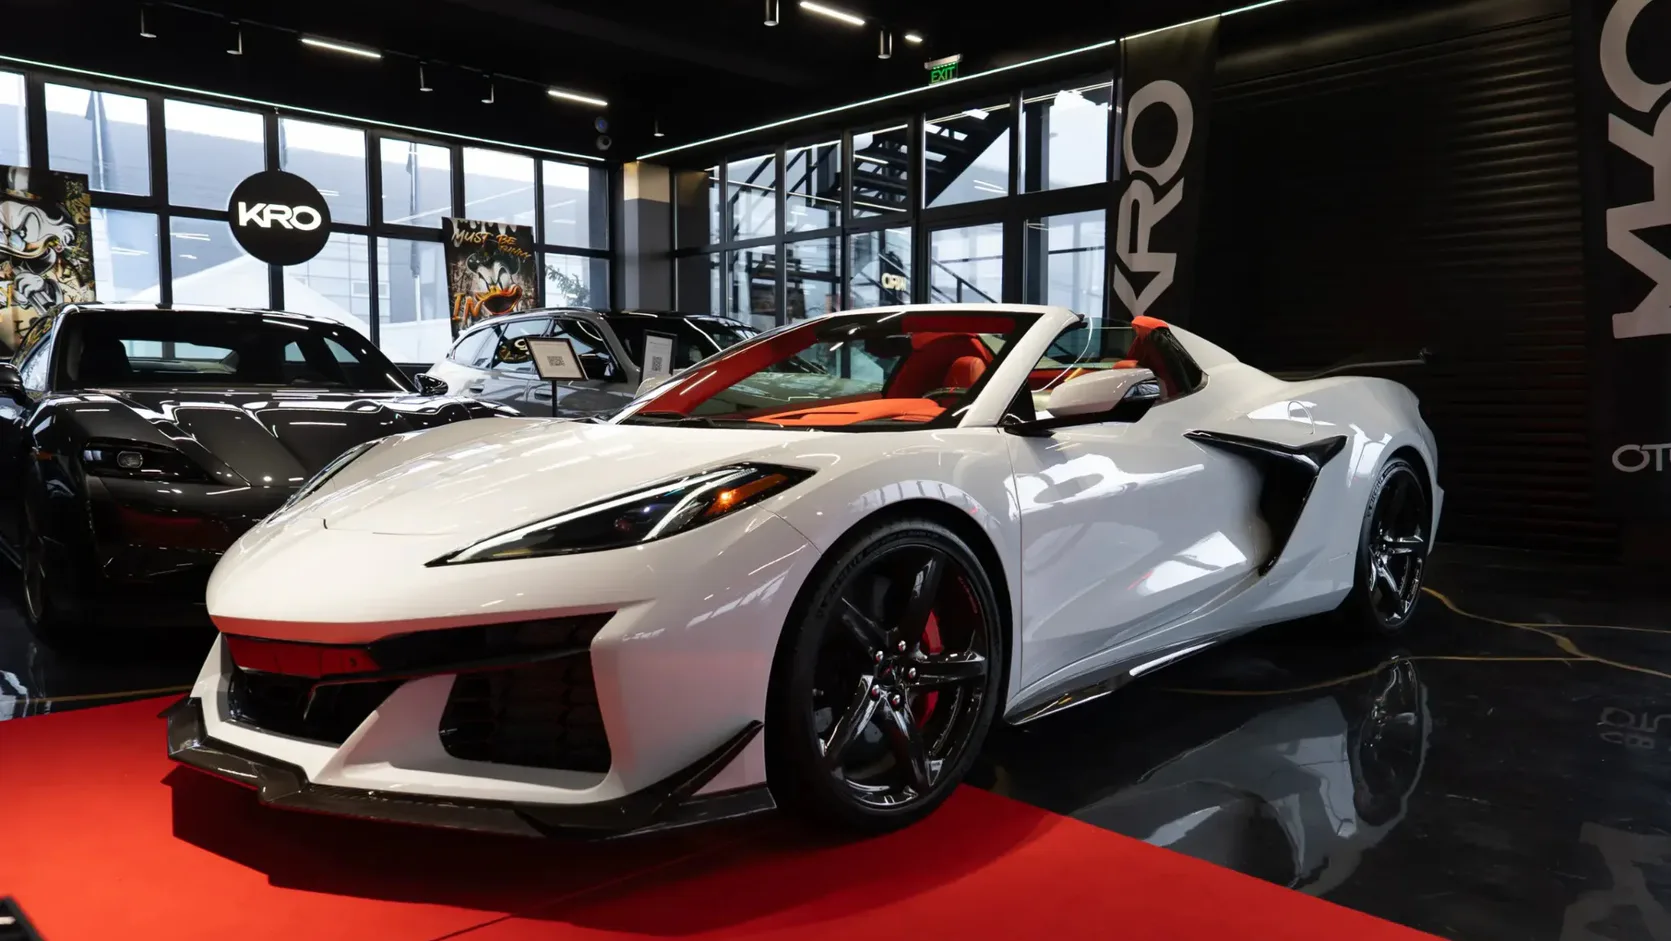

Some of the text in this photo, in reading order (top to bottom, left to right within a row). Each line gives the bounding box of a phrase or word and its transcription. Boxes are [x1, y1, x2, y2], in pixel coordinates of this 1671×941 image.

[931, 66, 955, 83] EXIT
[1113, 80, 1194, 317] KRO
[238, 201, 322, 231] KRO
[451, 229, 516, 245] MUST BE
[1612, 443, 1671, 472] OT
